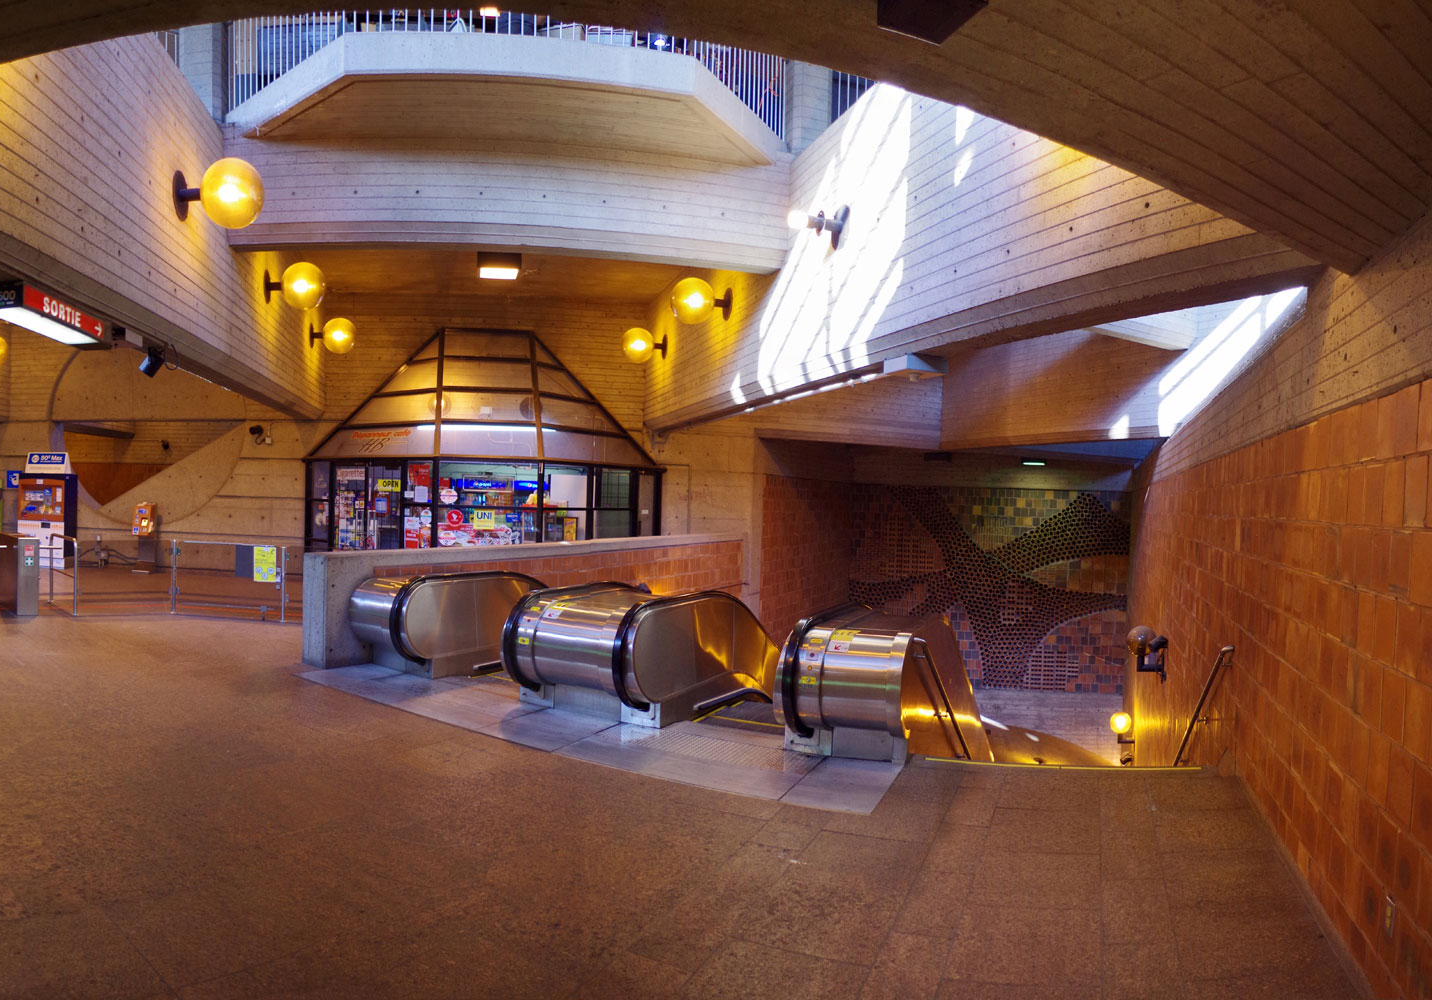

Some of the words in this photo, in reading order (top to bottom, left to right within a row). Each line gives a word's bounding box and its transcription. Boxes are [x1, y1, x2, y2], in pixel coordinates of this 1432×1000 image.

[43, 296, 81, 328] SORTIE
[382, 480, 399, 488] OPEN
[476, 511, 493, 520] UNI
